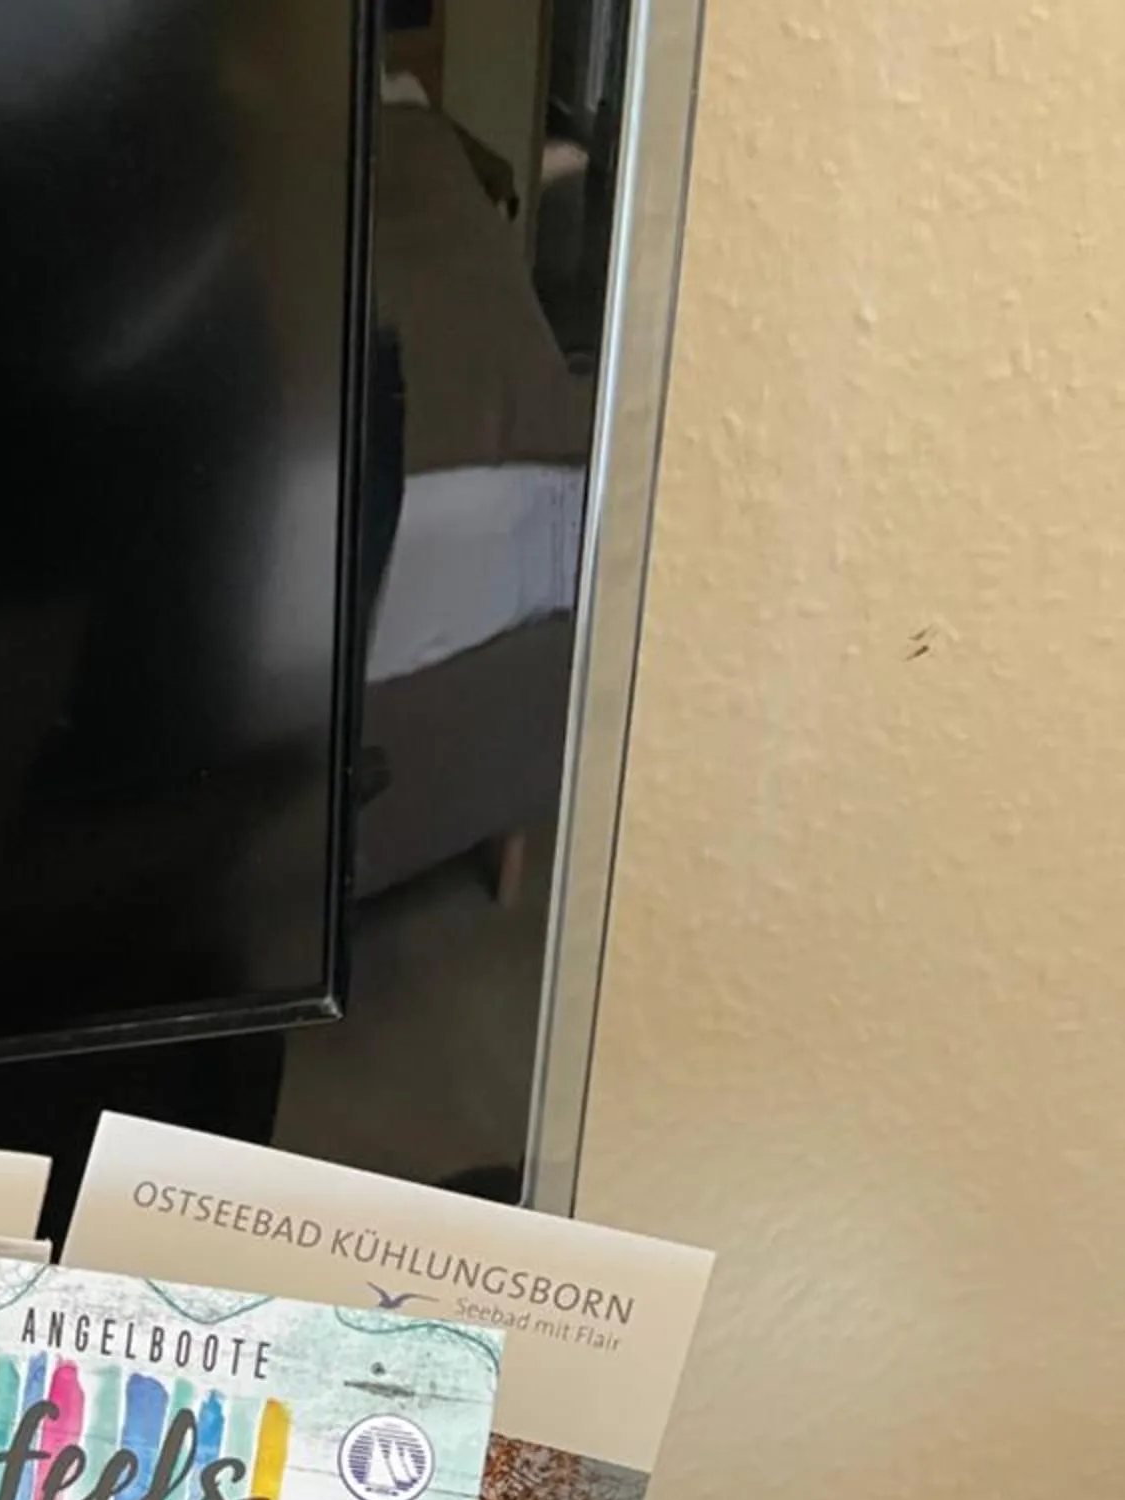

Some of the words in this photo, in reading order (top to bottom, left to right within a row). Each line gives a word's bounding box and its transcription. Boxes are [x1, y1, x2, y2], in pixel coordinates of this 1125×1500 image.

[133, 1180, 323, 1248] OSTSEEBAD
[330, 1228, 635, 1325] KÜHLUNGSBORN
[21, 1307, 271, 1380] ANGELBOOTE
[454, 1297, 531, 1331] Seebad
[535, 1317, 572, 1342] mit
[575, 1324, 622, 1352] Flair
